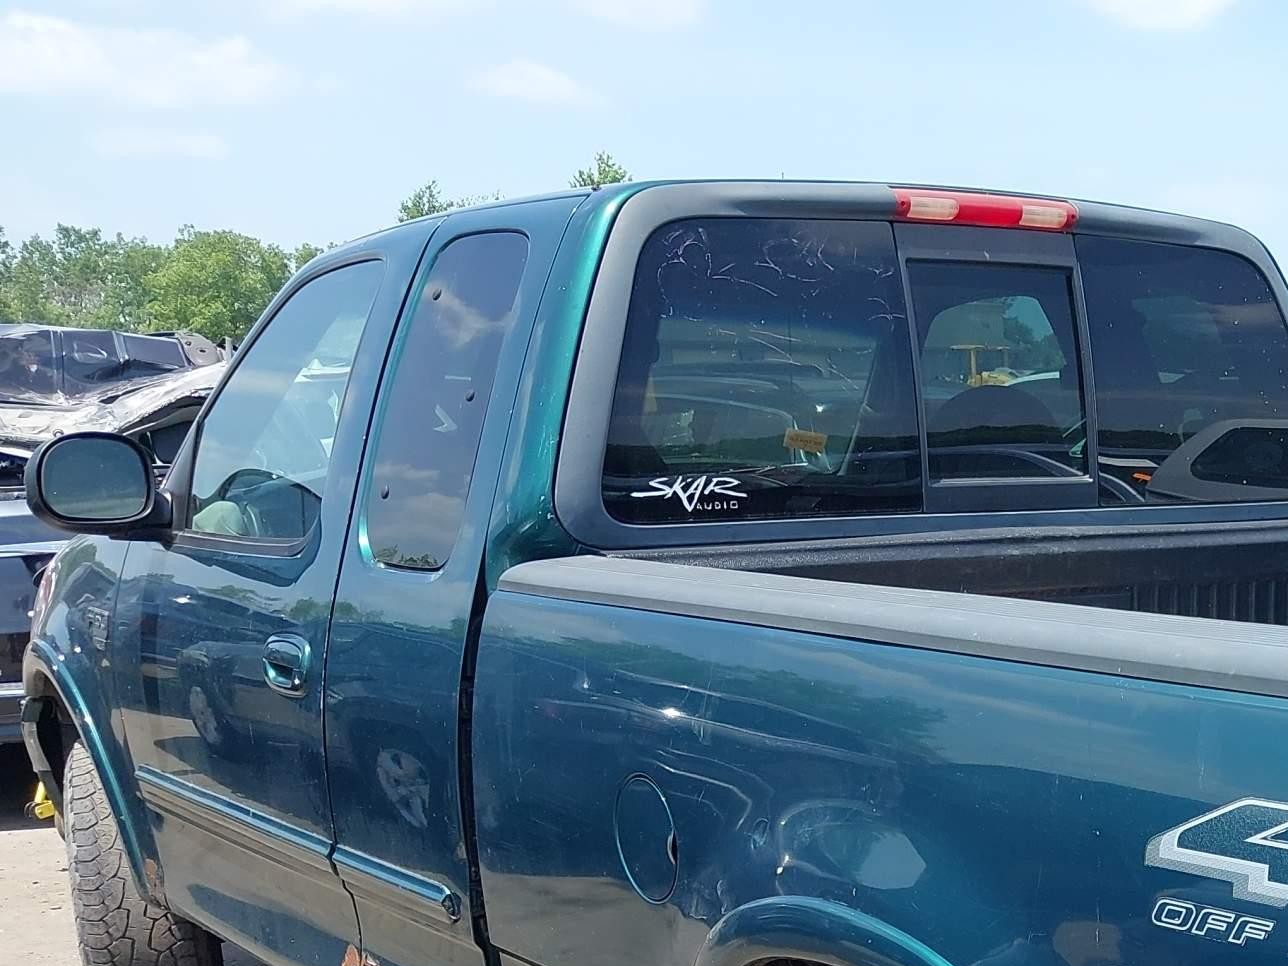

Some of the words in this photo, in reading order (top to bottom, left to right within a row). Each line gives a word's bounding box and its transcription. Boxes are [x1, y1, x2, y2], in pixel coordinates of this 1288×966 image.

[630, 475, 748, 512] SKAR
[696, 500, 739, 511] AUDIO
[1151, 896, 1276, 948] OFF
